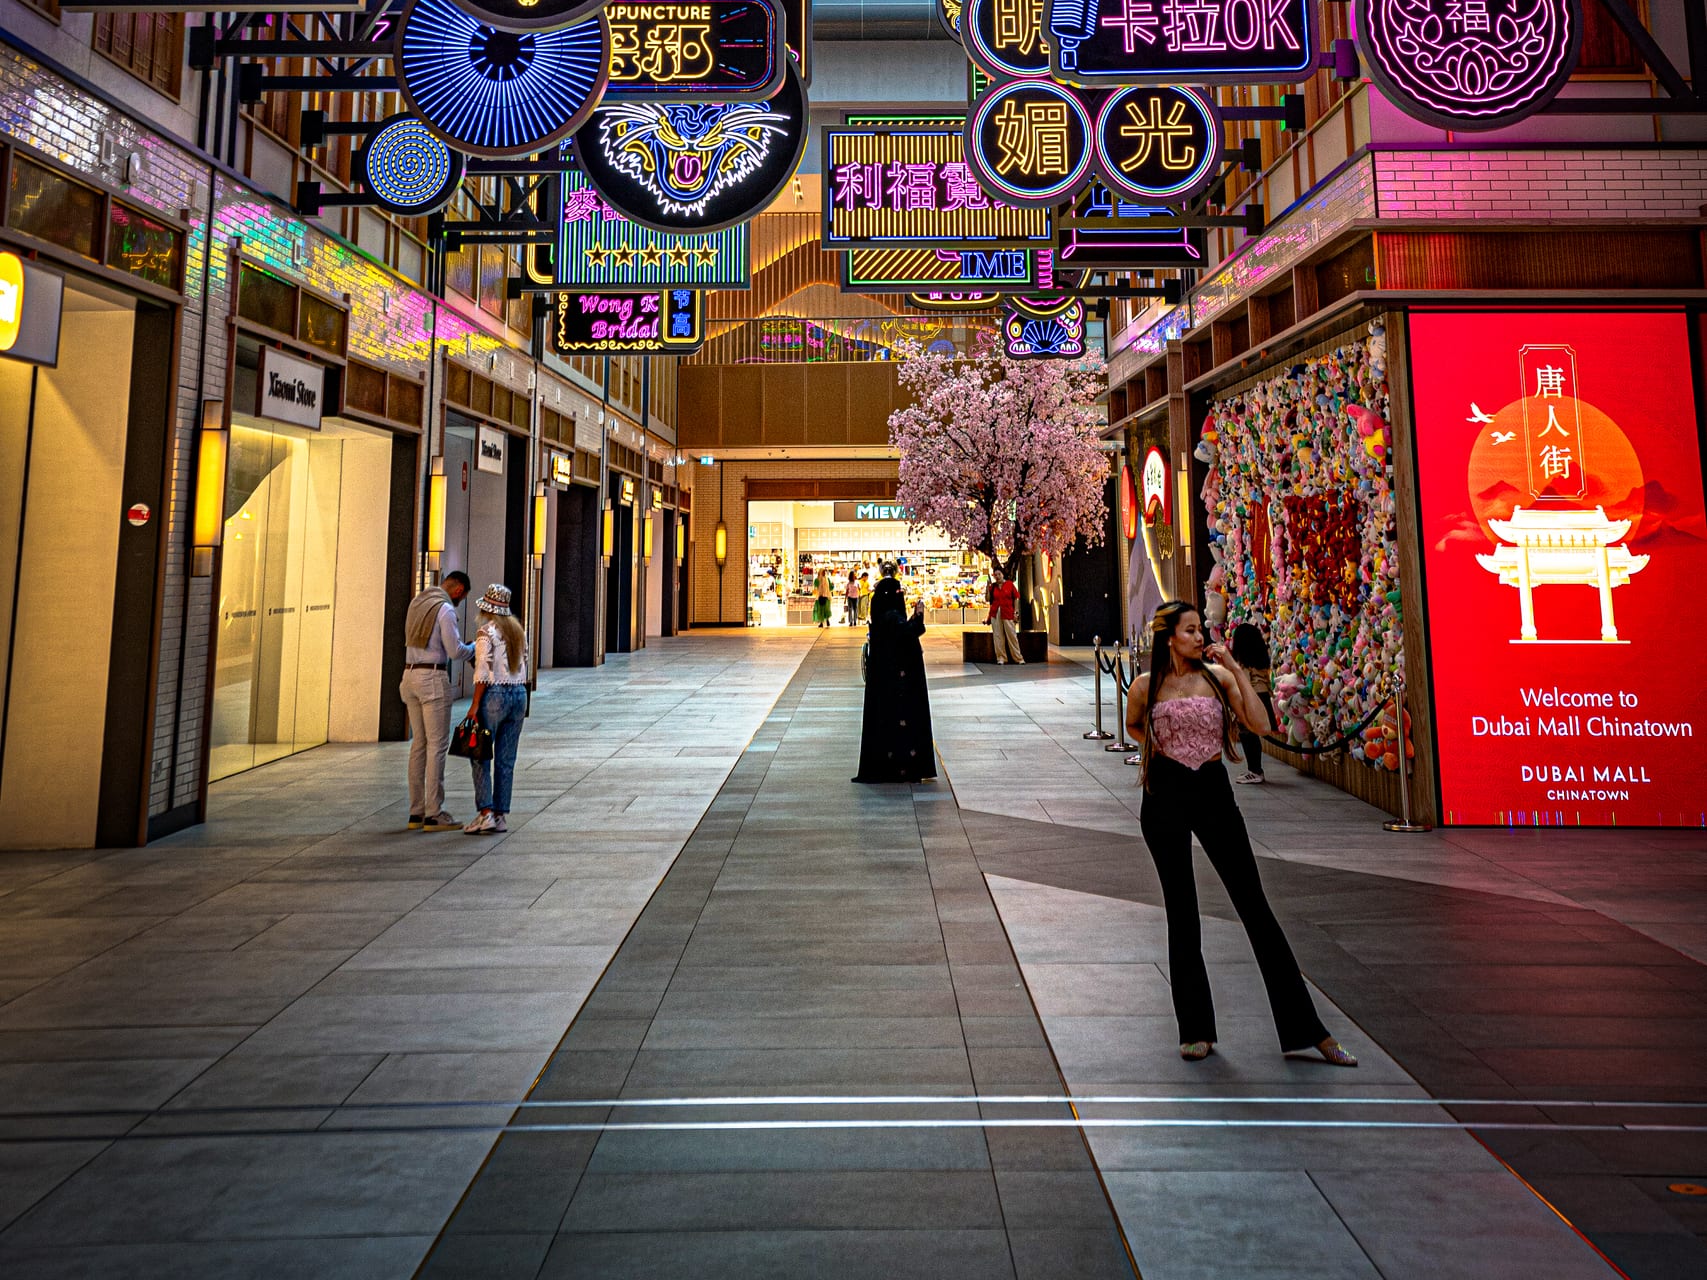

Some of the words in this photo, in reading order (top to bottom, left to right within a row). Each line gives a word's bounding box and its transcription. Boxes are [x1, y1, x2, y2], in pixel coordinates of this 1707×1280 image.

[835, 160, 1019, 213] 利福霓
[960, 251, 1027, 278] IME
[579, 294, 634, 320] Wong
[591, 316, 659, 340] Bridal
[1533, 365, 1573, 480] 唐人街
[856, 503, 916, 519] MIEV
[1519, 686, 1613, 707] Welcome
[1618, 690, 1638, 707] to
[1471, 715, 1530, 736] Dubai
[1538, 715, 1580, 736] Mall
[1586, 716, 1693, 737] Chinatown
[1521, 765, 1585, 782] DUBAI
[1592, 766, 1650, 783] MALL
[1547, 789, 1629, 800] CHINATOWN
